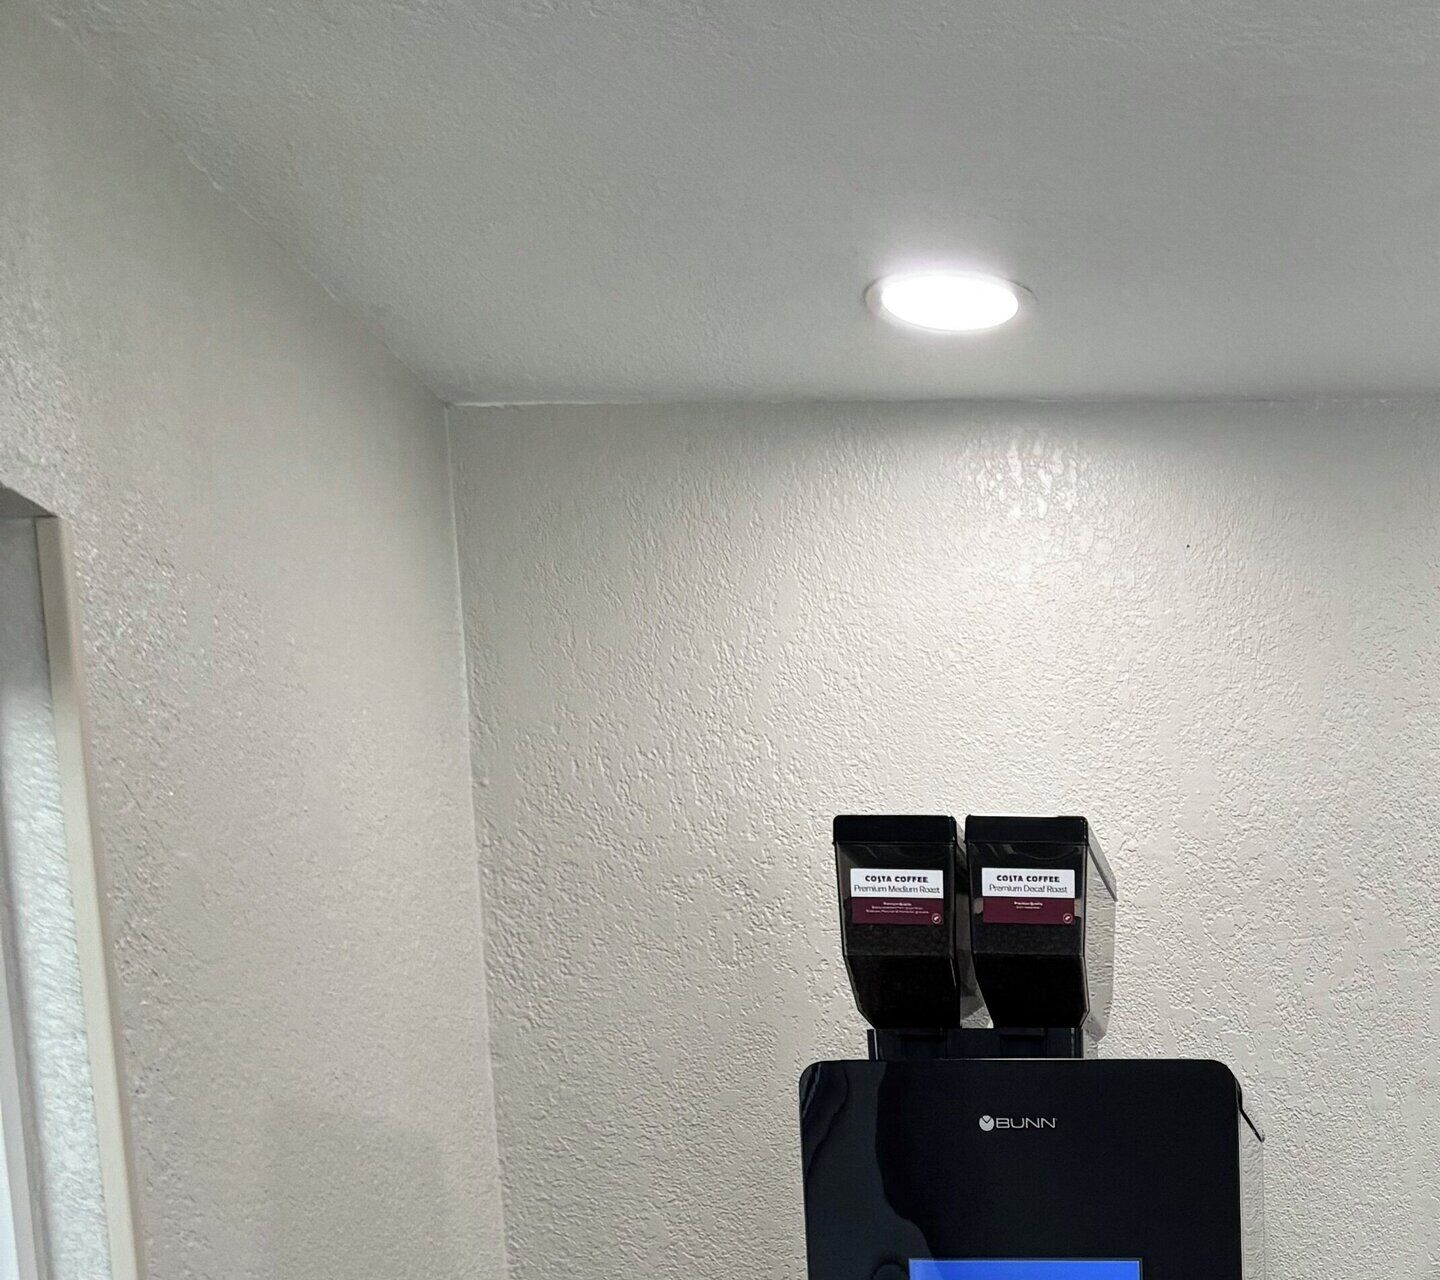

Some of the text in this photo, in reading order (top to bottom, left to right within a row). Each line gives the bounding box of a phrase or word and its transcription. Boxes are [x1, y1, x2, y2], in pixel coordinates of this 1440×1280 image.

[865, 875, 929, 883] COSTA COFFEE
[996, 874, 1060, 883] COSTA COFFEE
[854, 885, 940, 894] Premium Medium Roast
[989, 884, 1068, 893] Premium Decaf Roast
[995, 1117, 1056, 1129] BUNN
